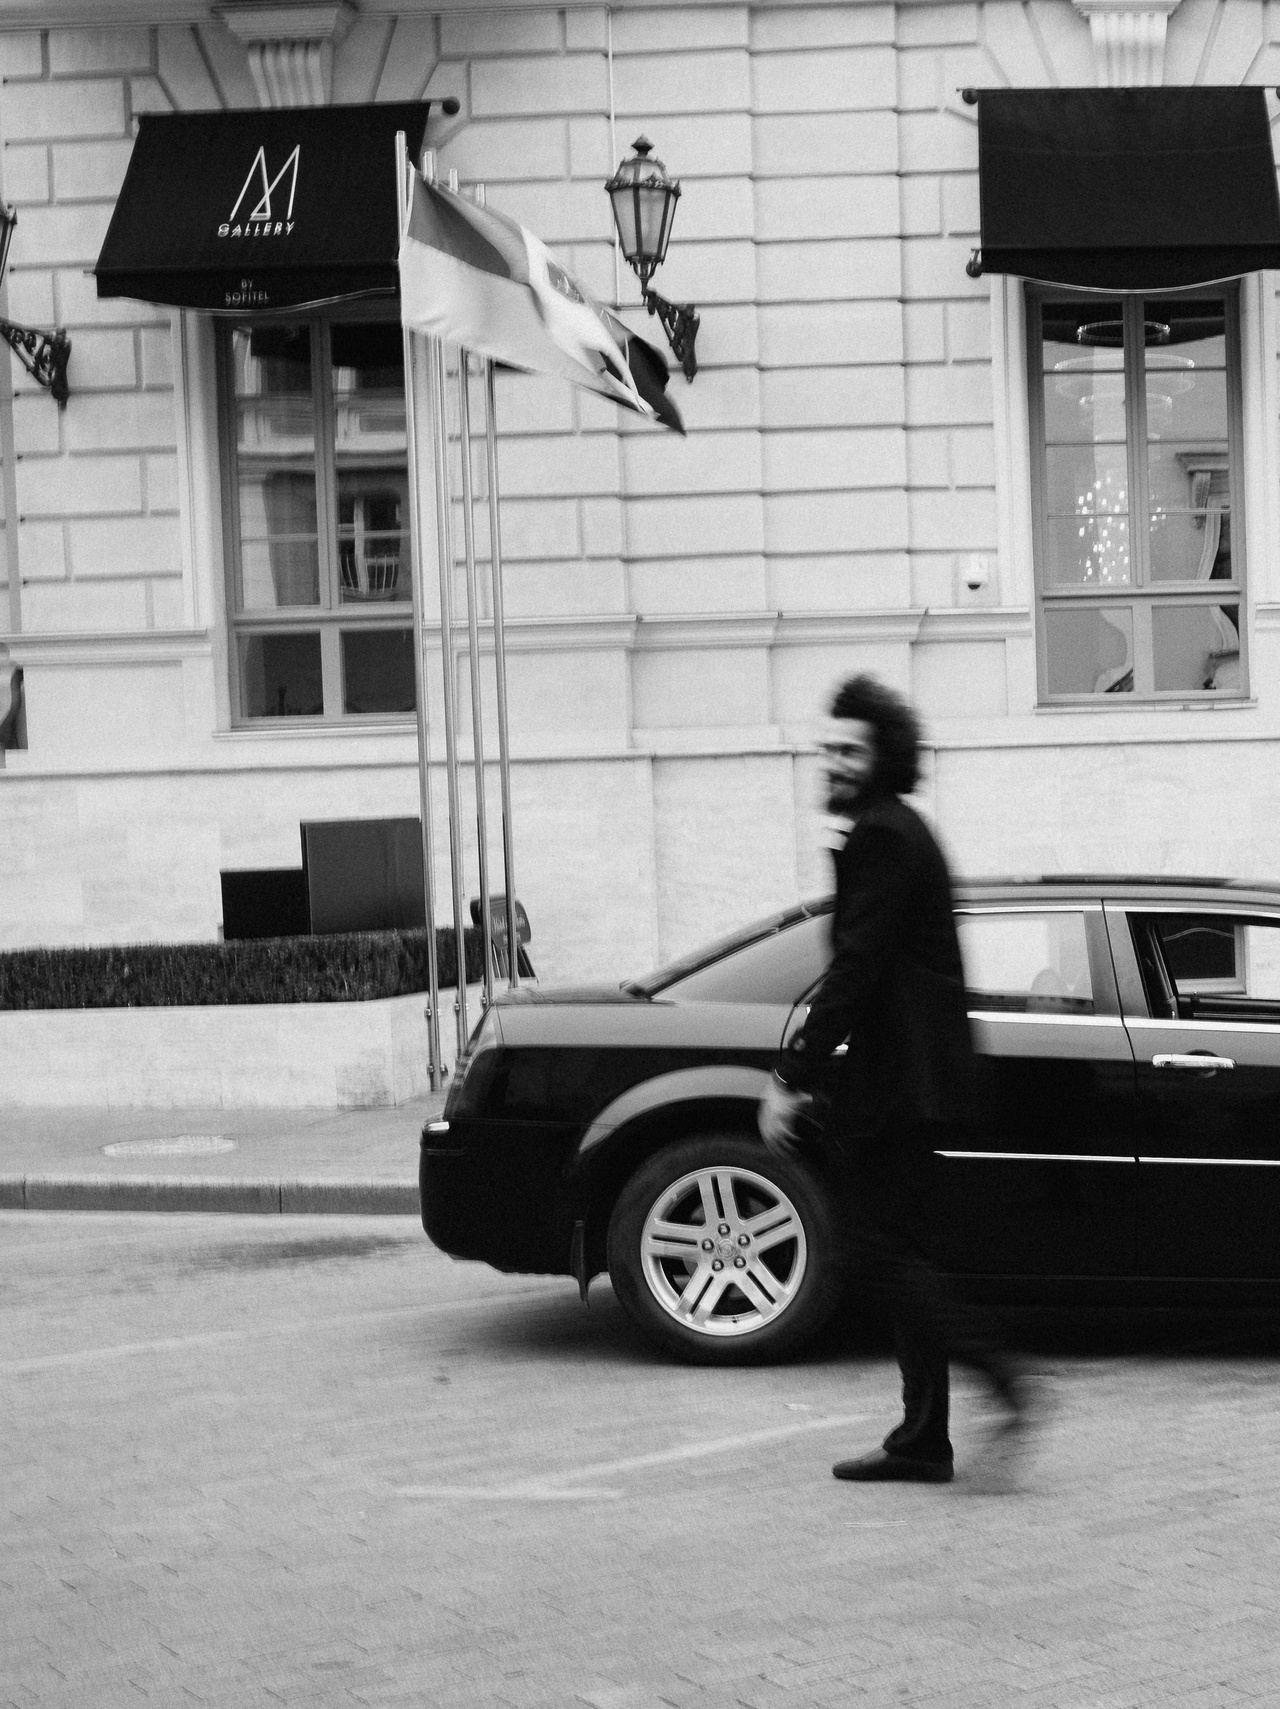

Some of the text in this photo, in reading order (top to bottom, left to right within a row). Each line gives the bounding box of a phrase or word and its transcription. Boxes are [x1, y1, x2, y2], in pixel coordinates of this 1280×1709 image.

[217, 221, 295, 238] GALLERY
[241, 279, 254, 289] BY
[225, 291, 270, 304] SOFITEL
